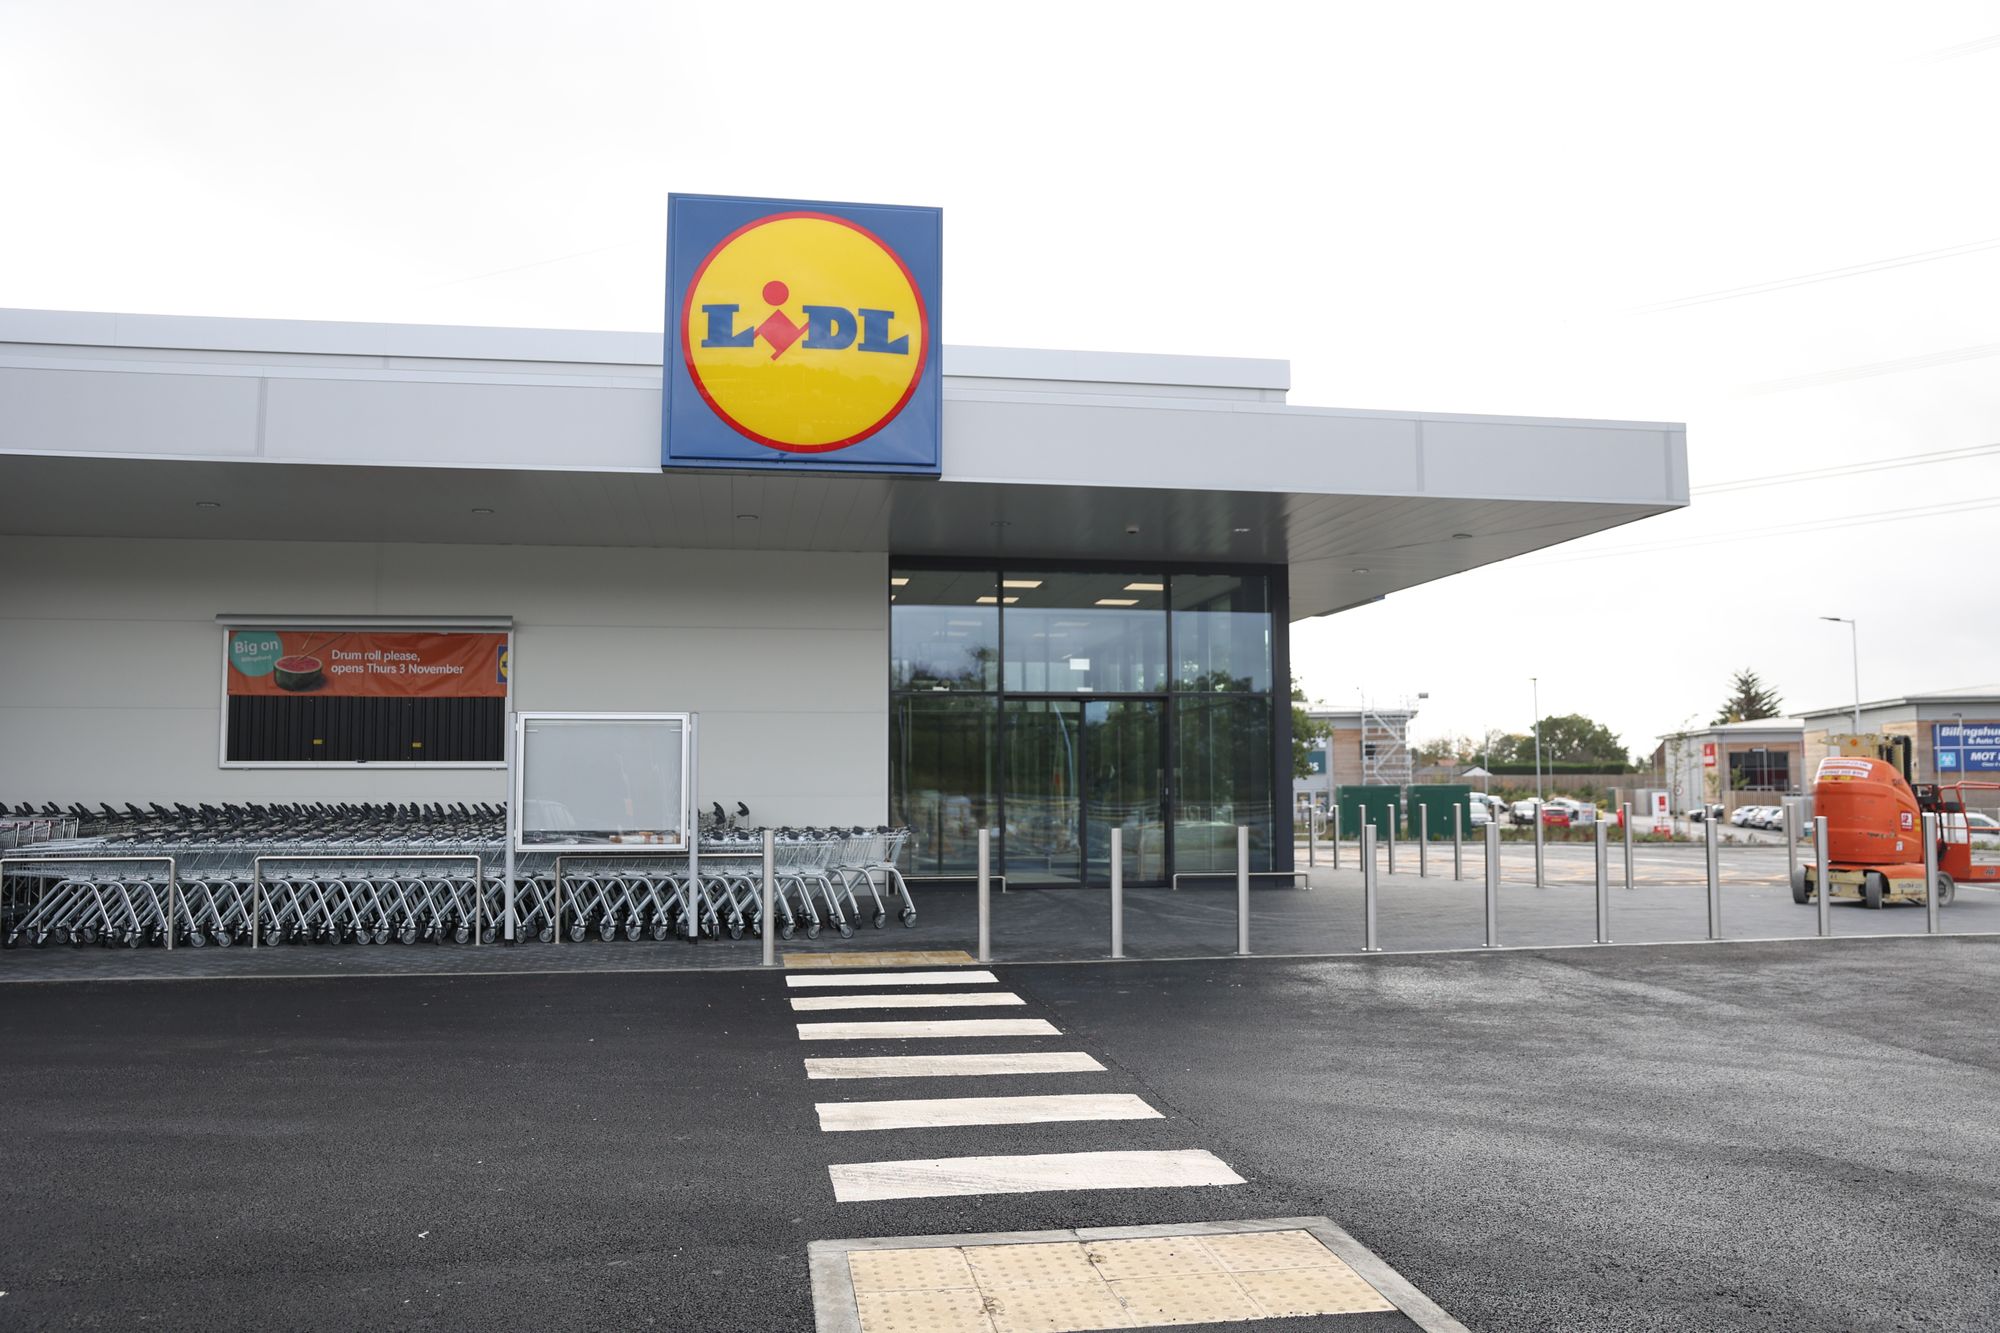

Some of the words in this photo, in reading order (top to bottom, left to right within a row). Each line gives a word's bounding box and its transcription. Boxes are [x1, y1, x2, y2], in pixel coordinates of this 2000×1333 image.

[235, 641, 257, 655] Big
[261, 640, 279, 651] on
[331, 649, 361, 660] Drum
[364, 650, 381, 660] roll
[384, 650, 420, 663] please,
[331, 664, 364, 675] opens
[367, 663, 397, 674] Thurs
[400, 664, 406, 674] 3
[408, 664, 464, 674] November
[1970, 752, 1997, 761] MOT
